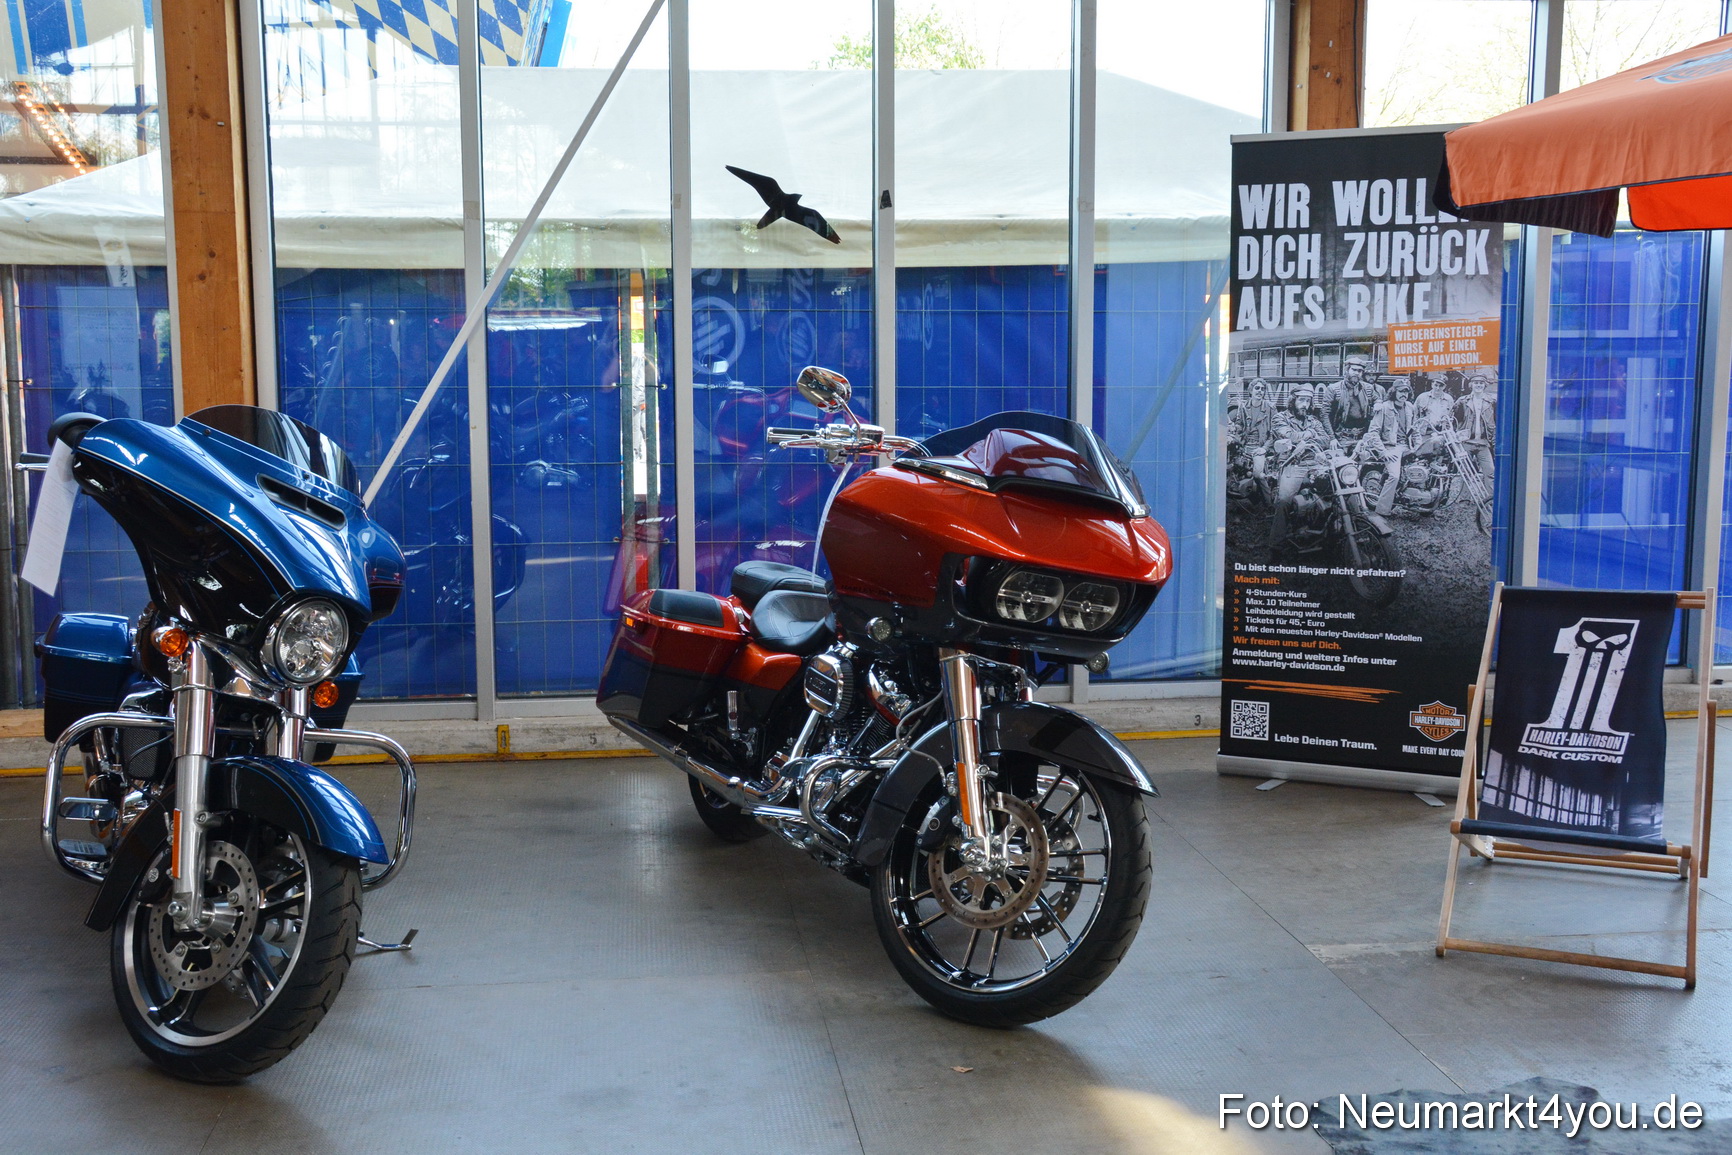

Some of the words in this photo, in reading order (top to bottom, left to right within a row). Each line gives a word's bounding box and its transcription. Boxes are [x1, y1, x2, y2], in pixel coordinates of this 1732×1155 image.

[1238, 183, 1310, 229] WIR
[1332, 178, 1469, 226] WOLL
[1238, 233, 1321, 280] DICH
[1342, 225, 1490, 278] ZURÜCK
[1236, 285, 1325, 330] AUFS
[1347, 282, 1431, 329] BIKE
[1394, 325, 1487, 341] WIEDEREINSTEIGER-
[1394, 342, 1424, 355] KURSE
[1428, 341, 1445, 353] AUF
[1449, 339, 1476, 352] EINER
[1234, 562, 1246, 571] Du
[1248, 563, 1267, 572] bist
[1268, 564, 1296, 573] schon
[1298, 565, 1328, 576] länger
[1330, 567, 1354, 575] nicht
[1356, 568, 1406, 577] gefahren?
[1234, 575, 1260, 584] Mach
[1261, 576, 1280, 584] mit:
[1246, 588, 1307, 598] 4-Stunden-Kurs
[1245, 597, 1265, 605] Max.
[1278, 599, 1320, 608] Teilnehmer
[1245, 607, 1303, 618] Leihbekleidung
[1305, 610, 1322, 618] wird
[1324, 611, 1355, 619] gestellt
[1245, 615, 1274, 624] Tickets
[1276, 617, 1287, 625] für
[1307, 619, 1325, 627] Euro
[1245, 625, 1258, 633] Mit
[1260, 626, 1275, 634] den
[1276, 628, 1313, 636] neuesten
[1384, 632, 1423, 642] Modellen
[1232, 635, 1248, 644] Wir
[1250, 637, 1280, 646] freuen
[1301, 640, 1316, 648] auf
[1318, 641, 1342, 650] Dich.
[1232, 647, 1283, 660] Anmeldung
[1285, 651, 1302, 660] und
[1304, 653, 1341, 662] weitere
[1342, 654, 1369, 664] Infos
[1370, 657, 1397, 666] unter
[1232, 658, 1345, 672] www.harley-davidson.de
[1194, 714, 1201, 727] 3
[1274, 733, 1299, 744] Lebe
[1302, 735, 1338, 747] Deinen
[1340, 738, 1377, 750] Traum.
[1528, 729, 1622, 750] HARLEY-DAVIDSON
[1402, 744, 1418, 753] MAKE
[1420, 746, 1437, 755] EVERY
[1438, 747, 1450, 756] DAY
[1517, 745, 1559, 760] DARK
[1560, 752, 1623, 764] CUSTOM
